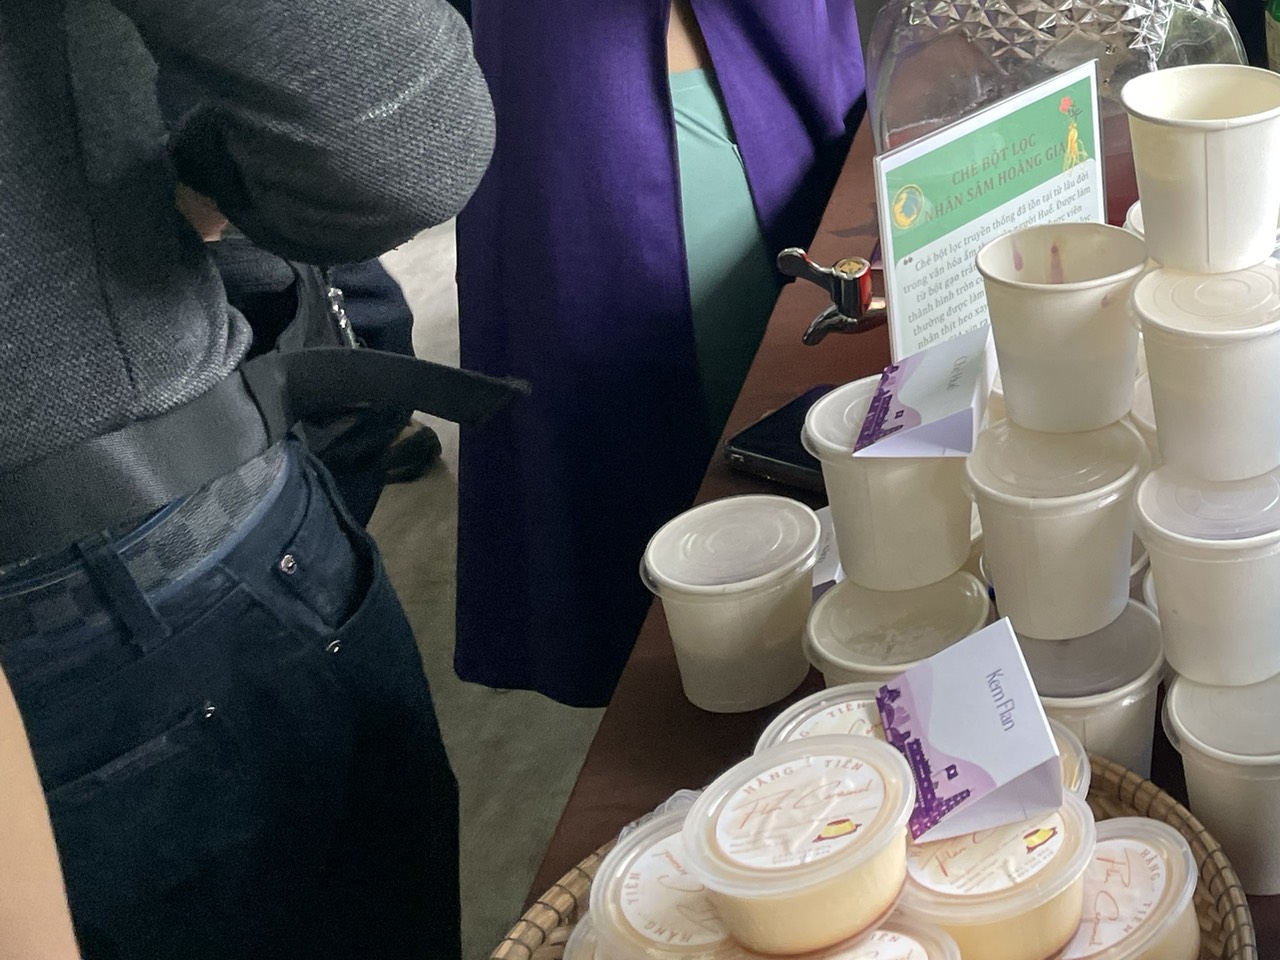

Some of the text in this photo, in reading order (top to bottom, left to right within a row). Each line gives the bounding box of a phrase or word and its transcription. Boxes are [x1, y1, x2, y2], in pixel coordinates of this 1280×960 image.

[982, 147, 1008, 170] BỘT
[1012, 133, 1036, 156] LỌC
[1045, 141, 1067, 161] GIA
[915, 256, 931, 271] Chè
[903, 275, 928, 294] trong
[985, 668, 1015, 732] Kem Flan
